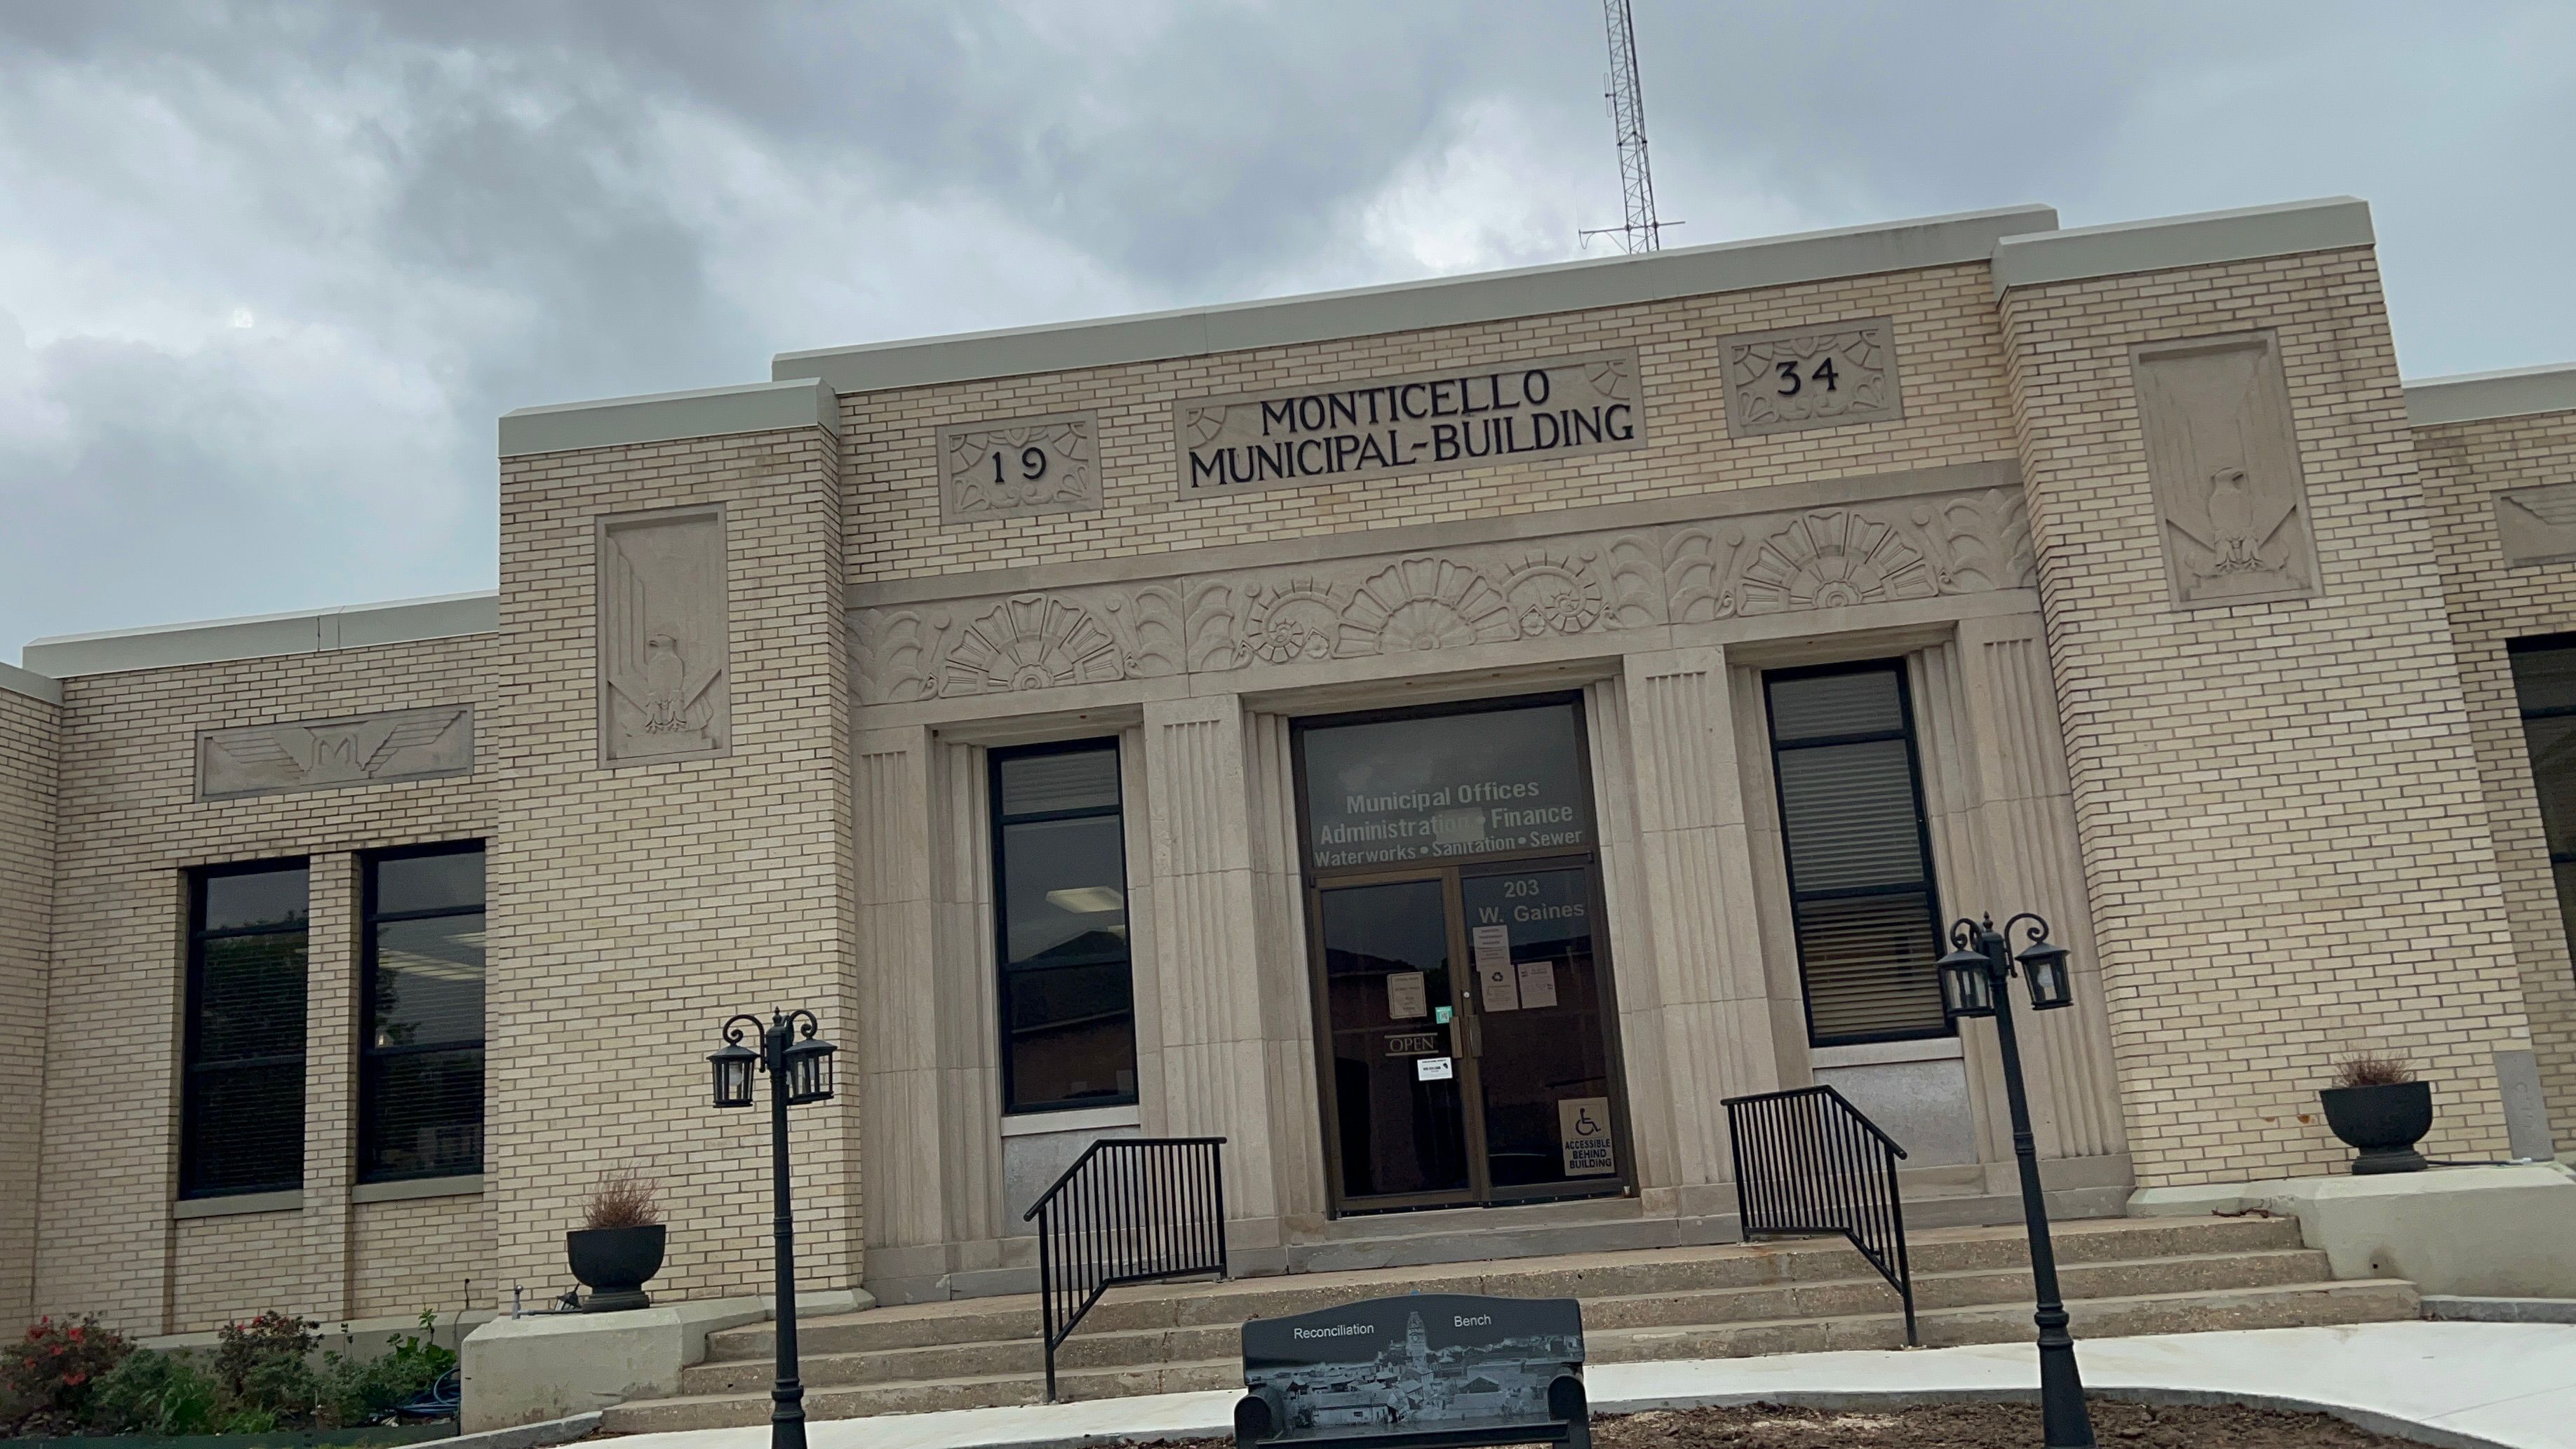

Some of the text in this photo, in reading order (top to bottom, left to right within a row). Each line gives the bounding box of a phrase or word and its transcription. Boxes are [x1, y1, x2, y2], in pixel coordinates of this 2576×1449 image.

[1776, 357, 1839, 396] 34
[1261, 369, 1550, 436] MONTICELLO
[1189, 403, 1634, 488] MUNICIPAL-BUILDING
[992, 447, 1047, 483] 19
[1346, 781, 1539, 814] Municipal Offices
[1320, 806, 1573, 845] Administration Finance
[1314, 830, 1583, 868] Waterworks Sanitation Sewer
[1504, 879, 1540, 898] 203
[1478, 903, 1585, 924] W. Gaines
[1390, 1037, 1434, 1052] OPEN
[1565, 1138, 1611, 1150] ACCESSIBLE
[1572, 1149, 1607, 1159] BEHIND
[1569, 1158, 1612, 1169] BUILDING
[1293, 1314, 1492, 1340] Reconciliation Bench
